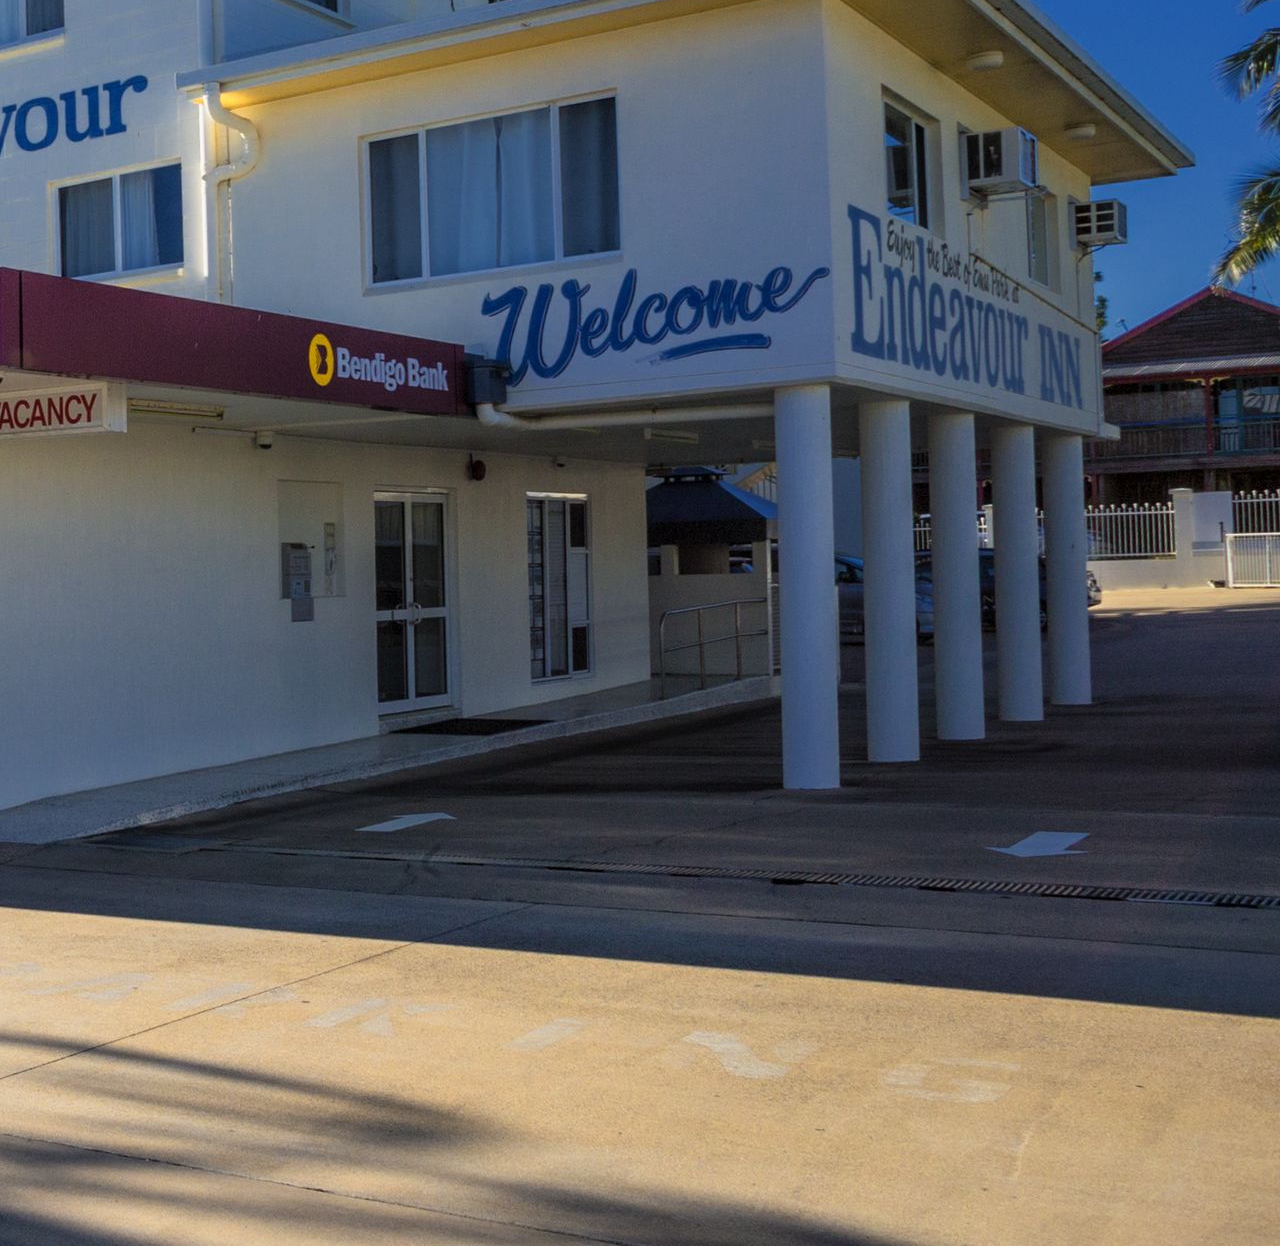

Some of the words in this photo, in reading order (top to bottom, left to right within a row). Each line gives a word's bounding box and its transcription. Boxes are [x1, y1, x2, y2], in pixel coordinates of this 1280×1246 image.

[941, 243, 961, 280] Best
[481, 266, 831, 387] Welcome
[847, 203, 1028, 396] Endeavour
[1038, 323, 1084, 410] INN
[336, 347, 406, 392] Bendigo
[406, 357, 449, 392] Bank
